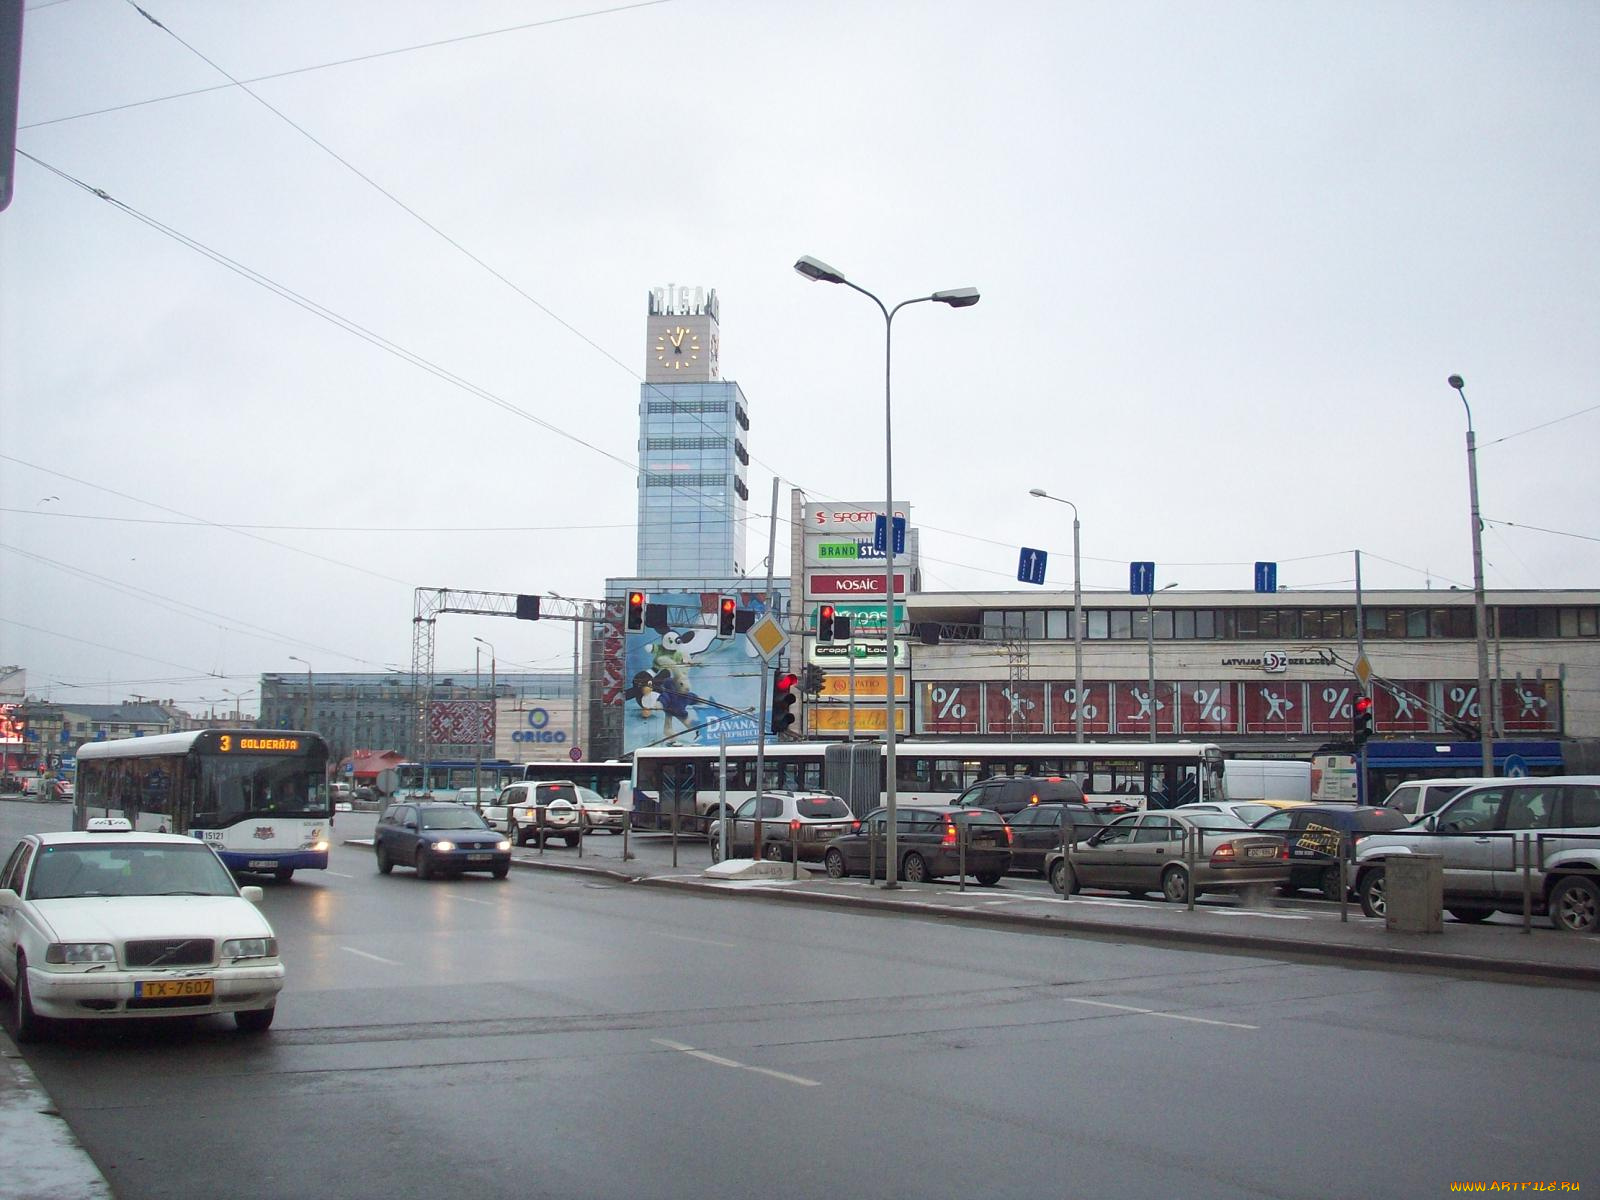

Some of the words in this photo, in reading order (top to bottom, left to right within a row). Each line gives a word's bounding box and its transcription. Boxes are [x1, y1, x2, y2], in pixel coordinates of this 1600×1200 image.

[821, 546, 855, 556] BRAND
[1221, 658, 1261, 666] LATVIJAS
[512, 731, 566, 742] ORIGO
[220, 735, 231, 751] 3
[240, 739, 297, 750] BOLDERĀJA
[205, 832, 223, 840] 15121
[146, 981, 210, 995] TX-7607
